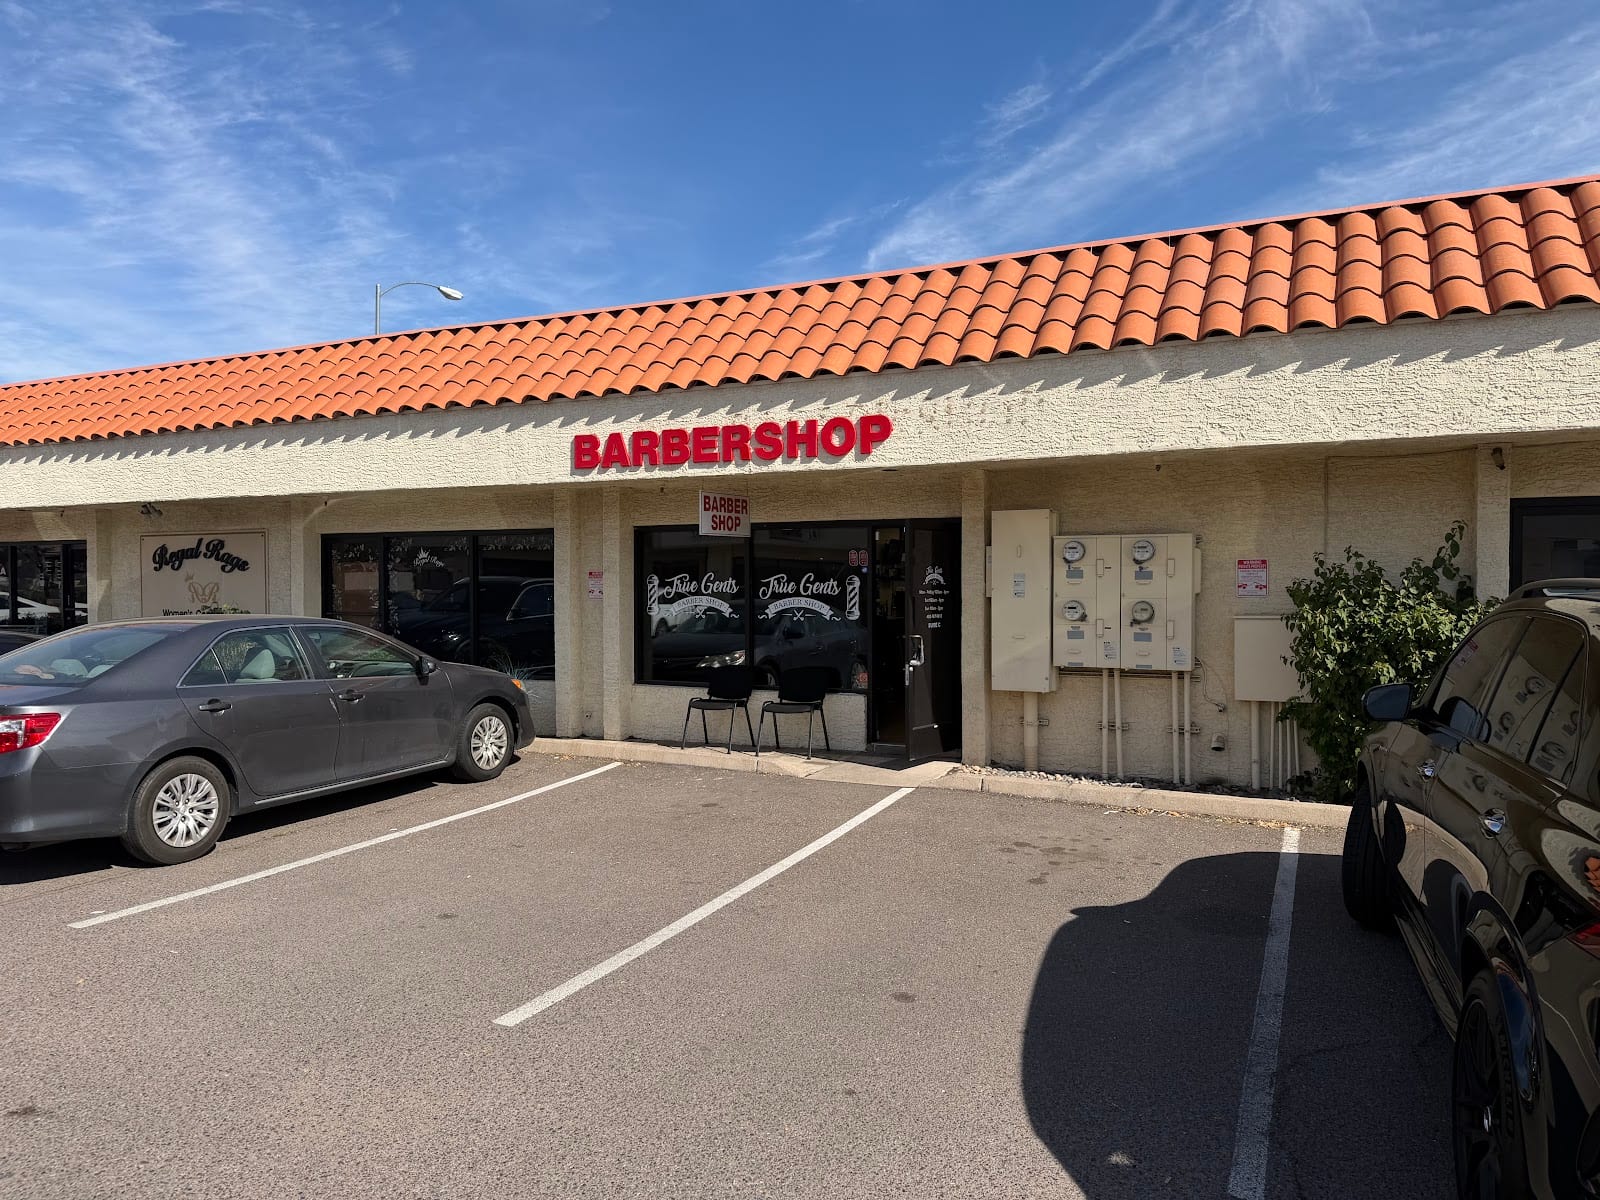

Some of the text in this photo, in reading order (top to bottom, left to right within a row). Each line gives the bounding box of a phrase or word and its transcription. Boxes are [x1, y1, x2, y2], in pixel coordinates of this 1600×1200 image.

[573, 413, 893, 470] BARBERSHOP
[703, 495, 748, 515] BARBER
[711, 514, 741, 532] SHOP
[663, 572, 740, 599] True Gents
[759, 572, 842, 600] True Gents
[677, 597, 724, 608] BARBER SHOP
[773, 599, 825, 610] BARBER SHOP
